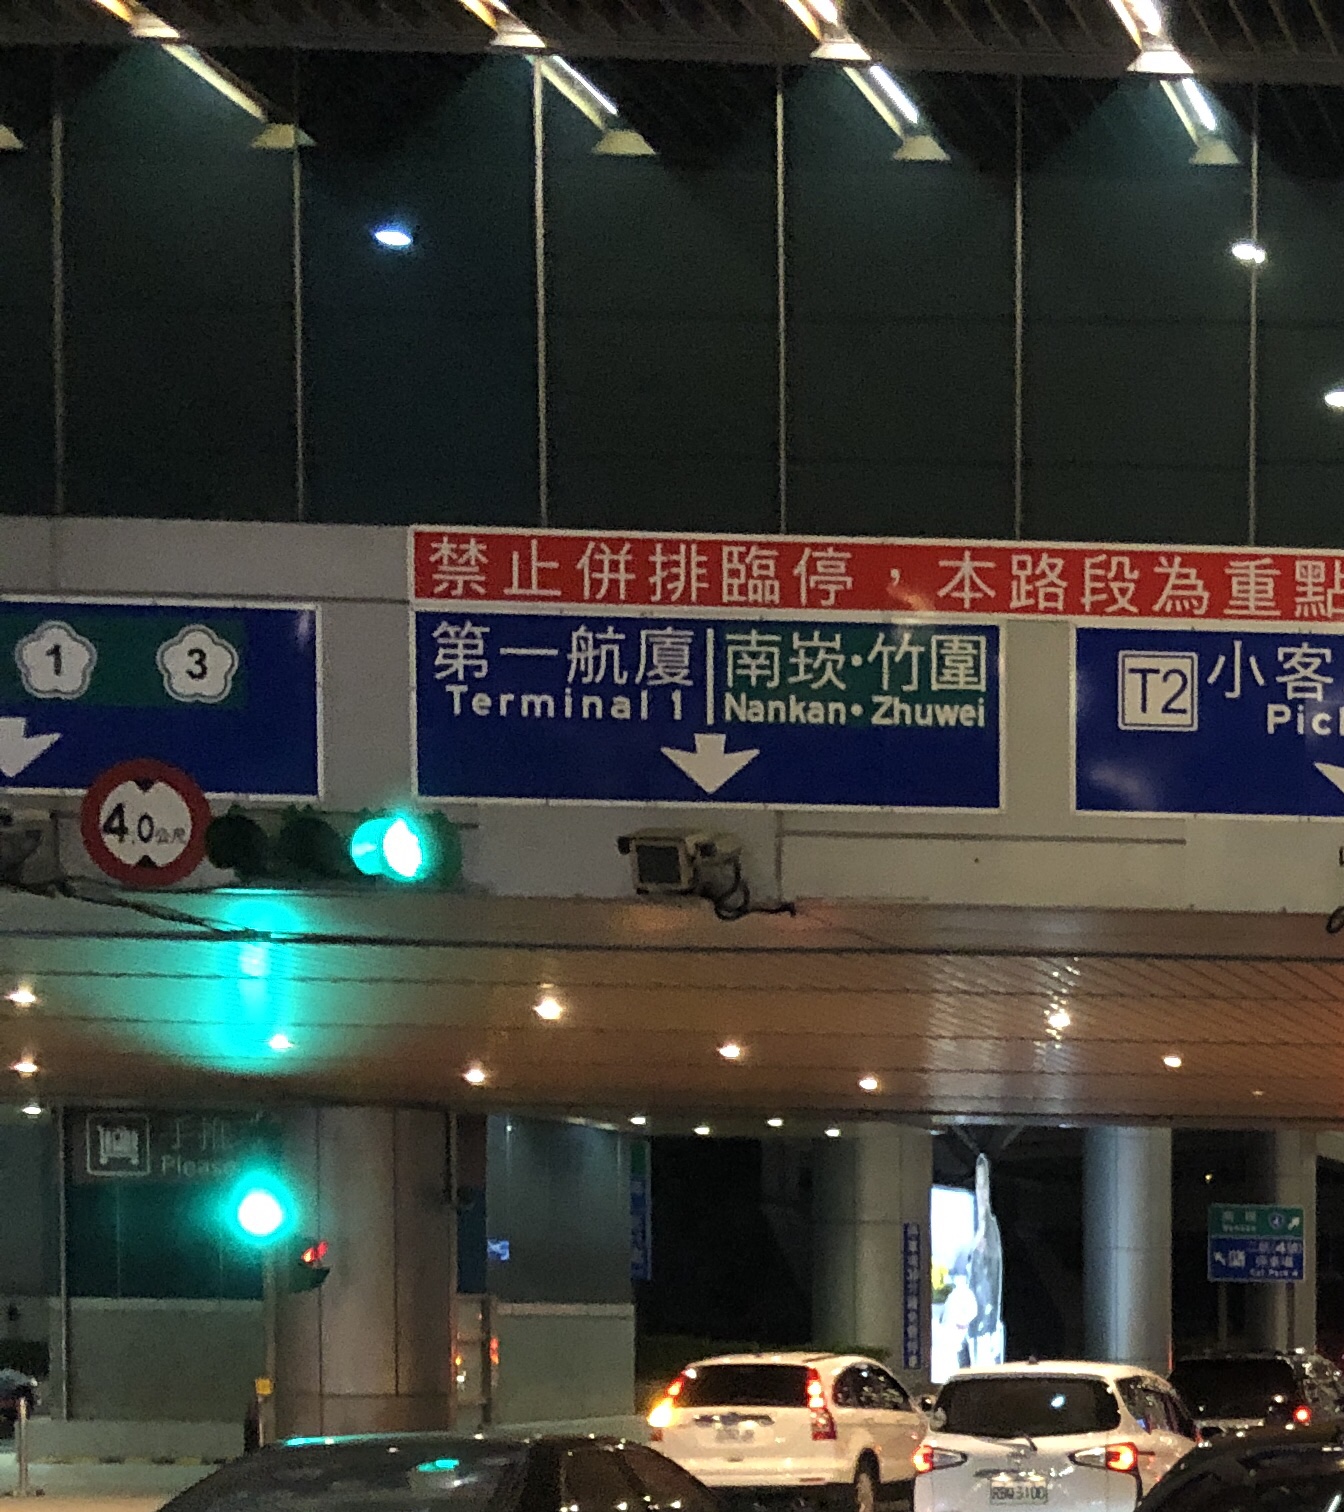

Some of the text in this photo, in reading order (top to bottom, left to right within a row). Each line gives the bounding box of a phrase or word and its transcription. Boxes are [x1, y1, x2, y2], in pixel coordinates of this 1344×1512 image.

[46, 644, 62, 676] 1
[186, 648, 208, 680] 3
[432, 619, 695, 686] 第一航廈
[445, 684, 682, 720] Terminal 1
[1128, 668, 1189, 714] T2
